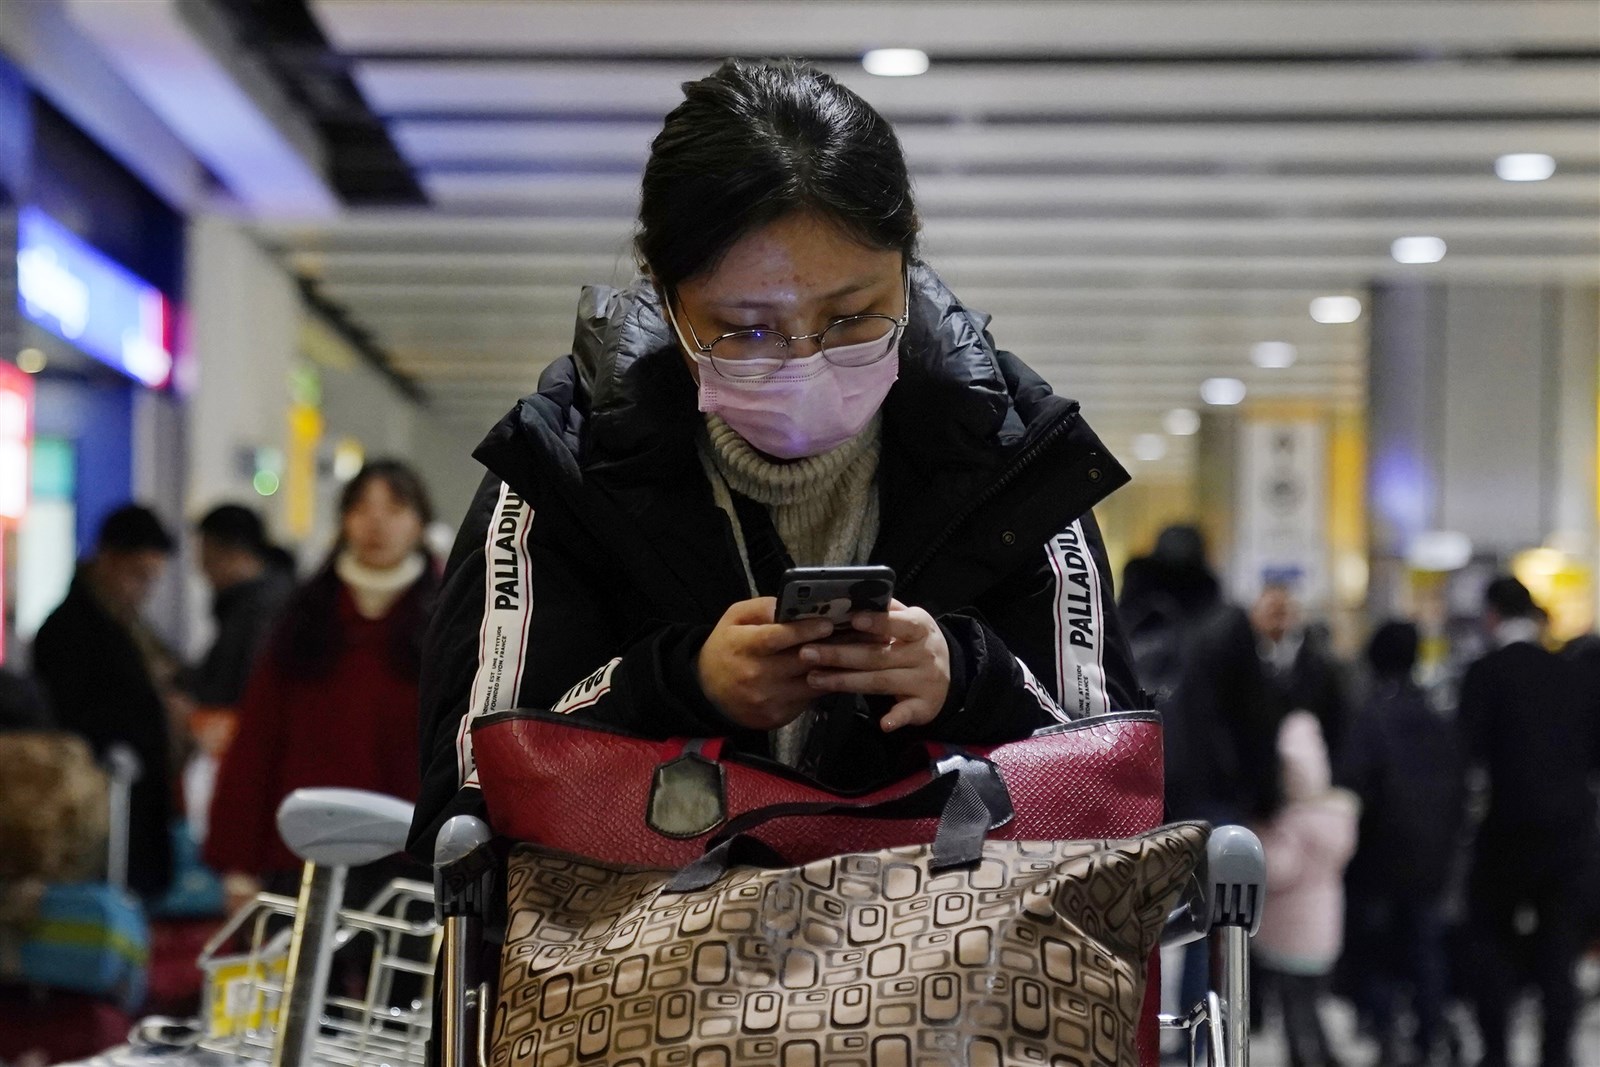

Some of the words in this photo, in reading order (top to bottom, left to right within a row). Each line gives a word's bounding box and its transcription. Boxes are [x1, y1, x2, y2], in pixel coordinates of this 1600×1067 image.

[495, 494, 524, 611] PALLADIU
[1057, 528, 1094, 650] PALLADIU
[490, 682, 500, 711] FOUNDED
[499, 635, 507, 658] FRANCE
[495, 625, 503, 654] ATTITUDE
